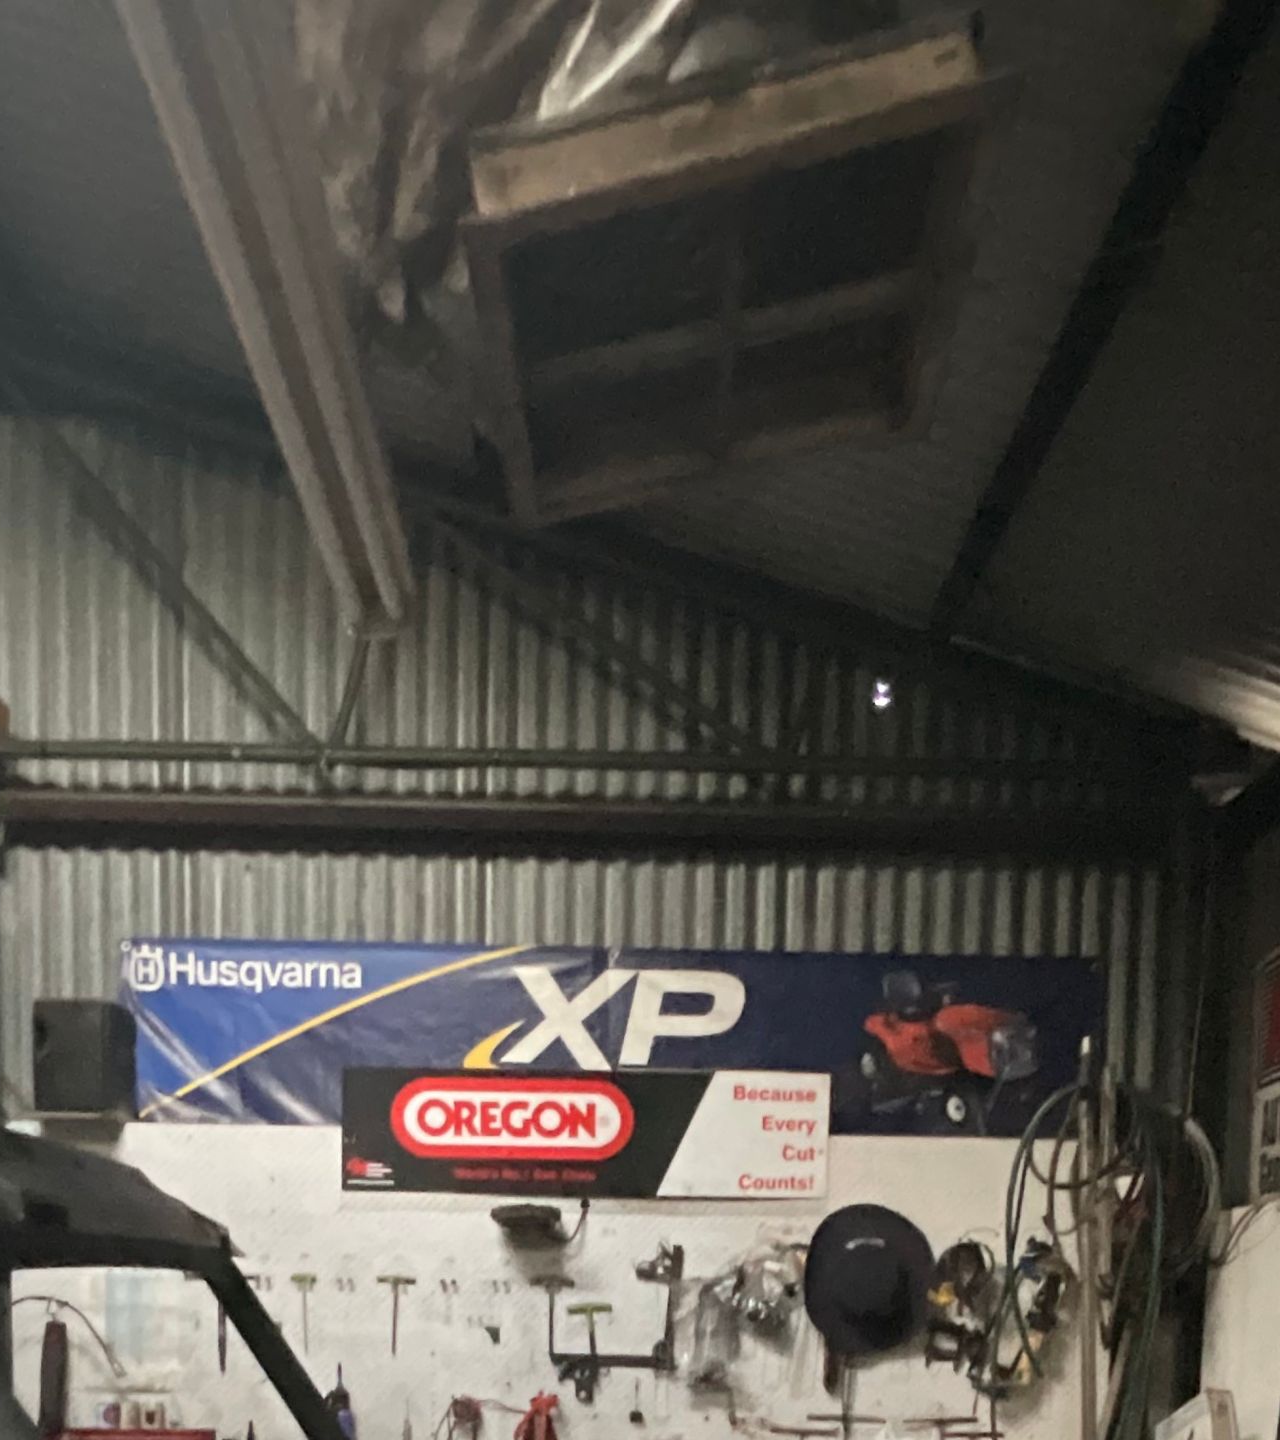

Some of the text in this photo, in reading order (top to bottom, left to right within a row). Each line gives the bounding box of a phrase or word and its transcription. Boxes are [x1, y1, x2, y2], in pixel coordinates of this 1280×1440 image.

[169, 951, 363, 994] Husqvarna
[500, 965, 746, 1071] XP
[732, 1085, 817, 1103] Because
[417, 1098, 597, 1139] OREGON
[761, 1115, 817, 1133] Every
[781, 1144, 816, 1162] Cut
[737, 1174, 816, 1191] Counts!
